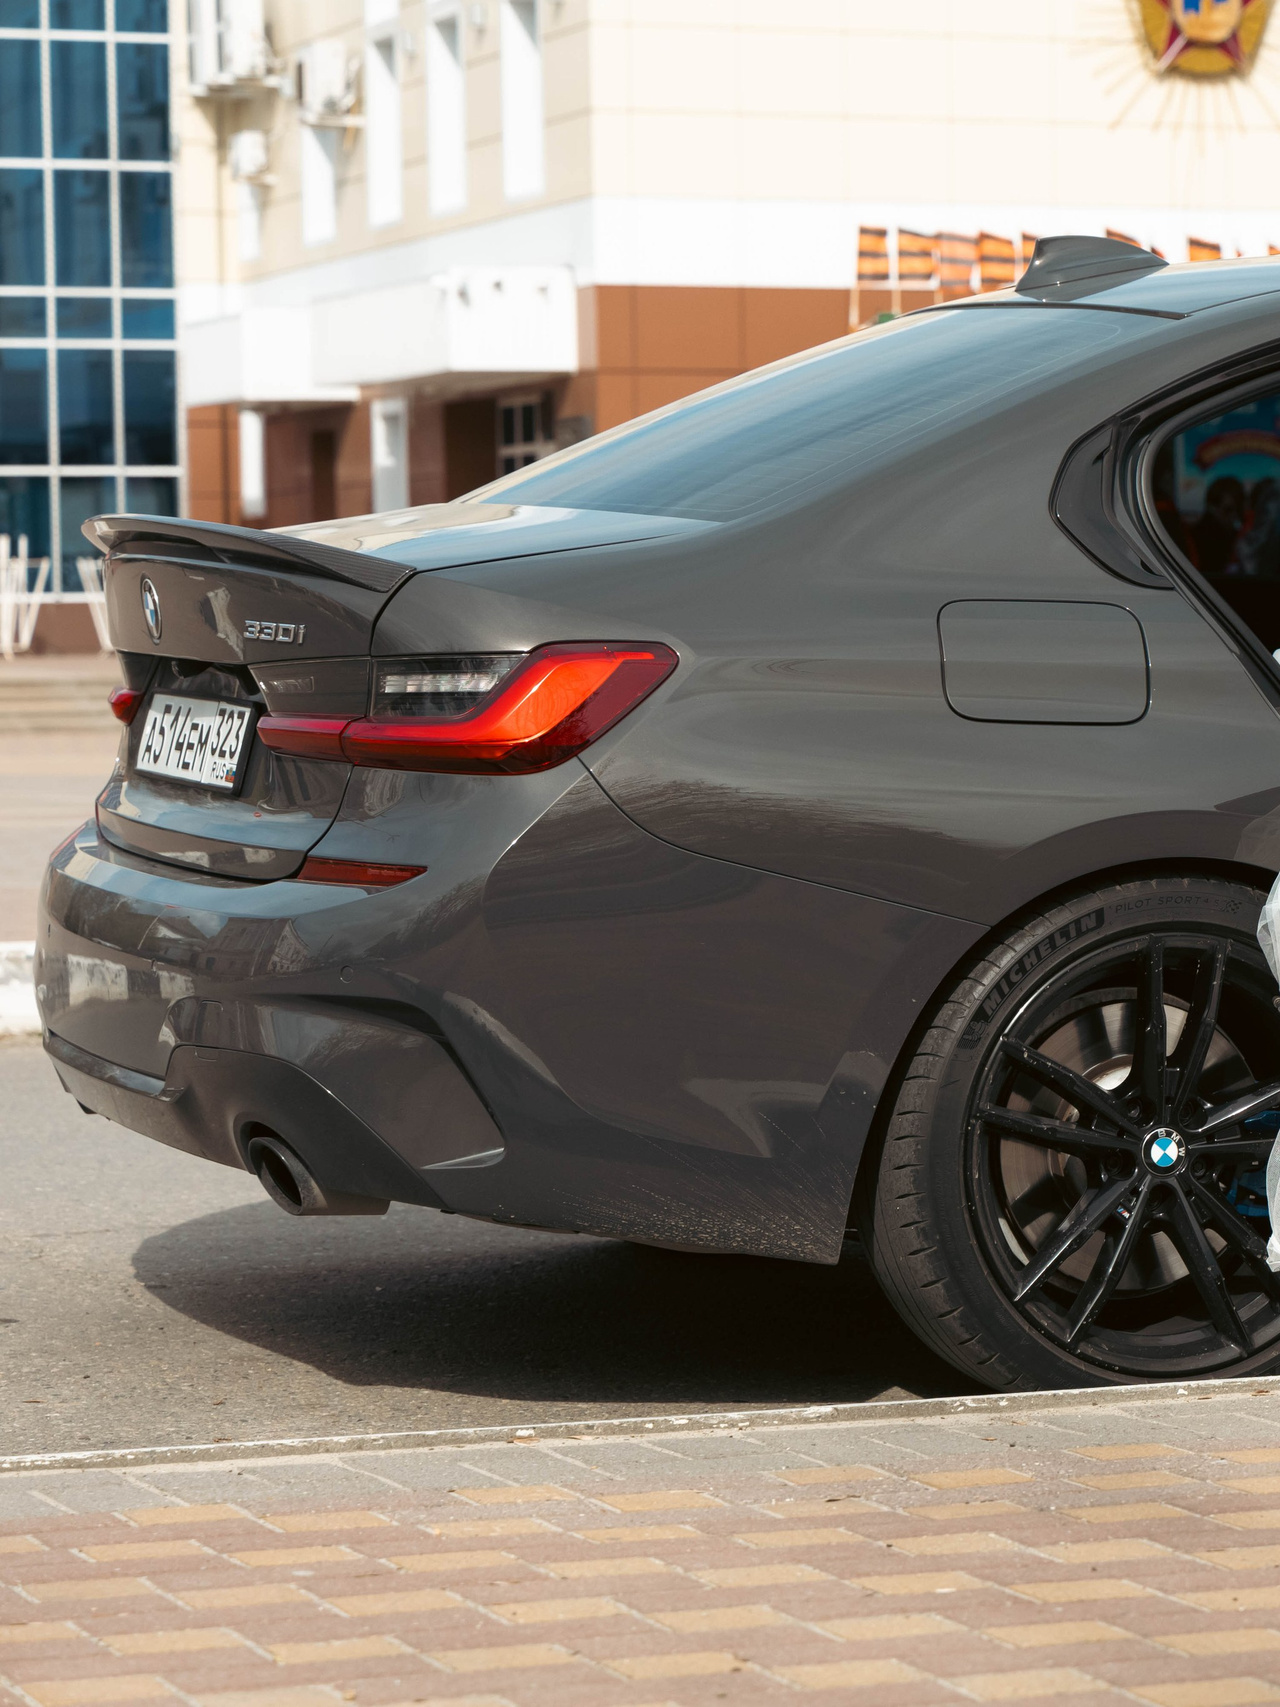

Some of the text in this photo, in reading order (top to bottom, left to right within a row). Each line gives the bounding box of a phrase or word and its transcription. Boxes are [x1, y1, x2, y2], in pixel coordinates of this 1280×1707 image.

[243, 620, 306, 644] 330i
[210, 708, 247, 760] 323
[211, 761, 227, 780] RUS
[1115, 898, 1152, 914] PILOT
[1157, 896, 1202, 906] SPORT
[982, 911, 1098, 1017] MICHELIN
[1157, 1129, 1186, 1158] BMW
